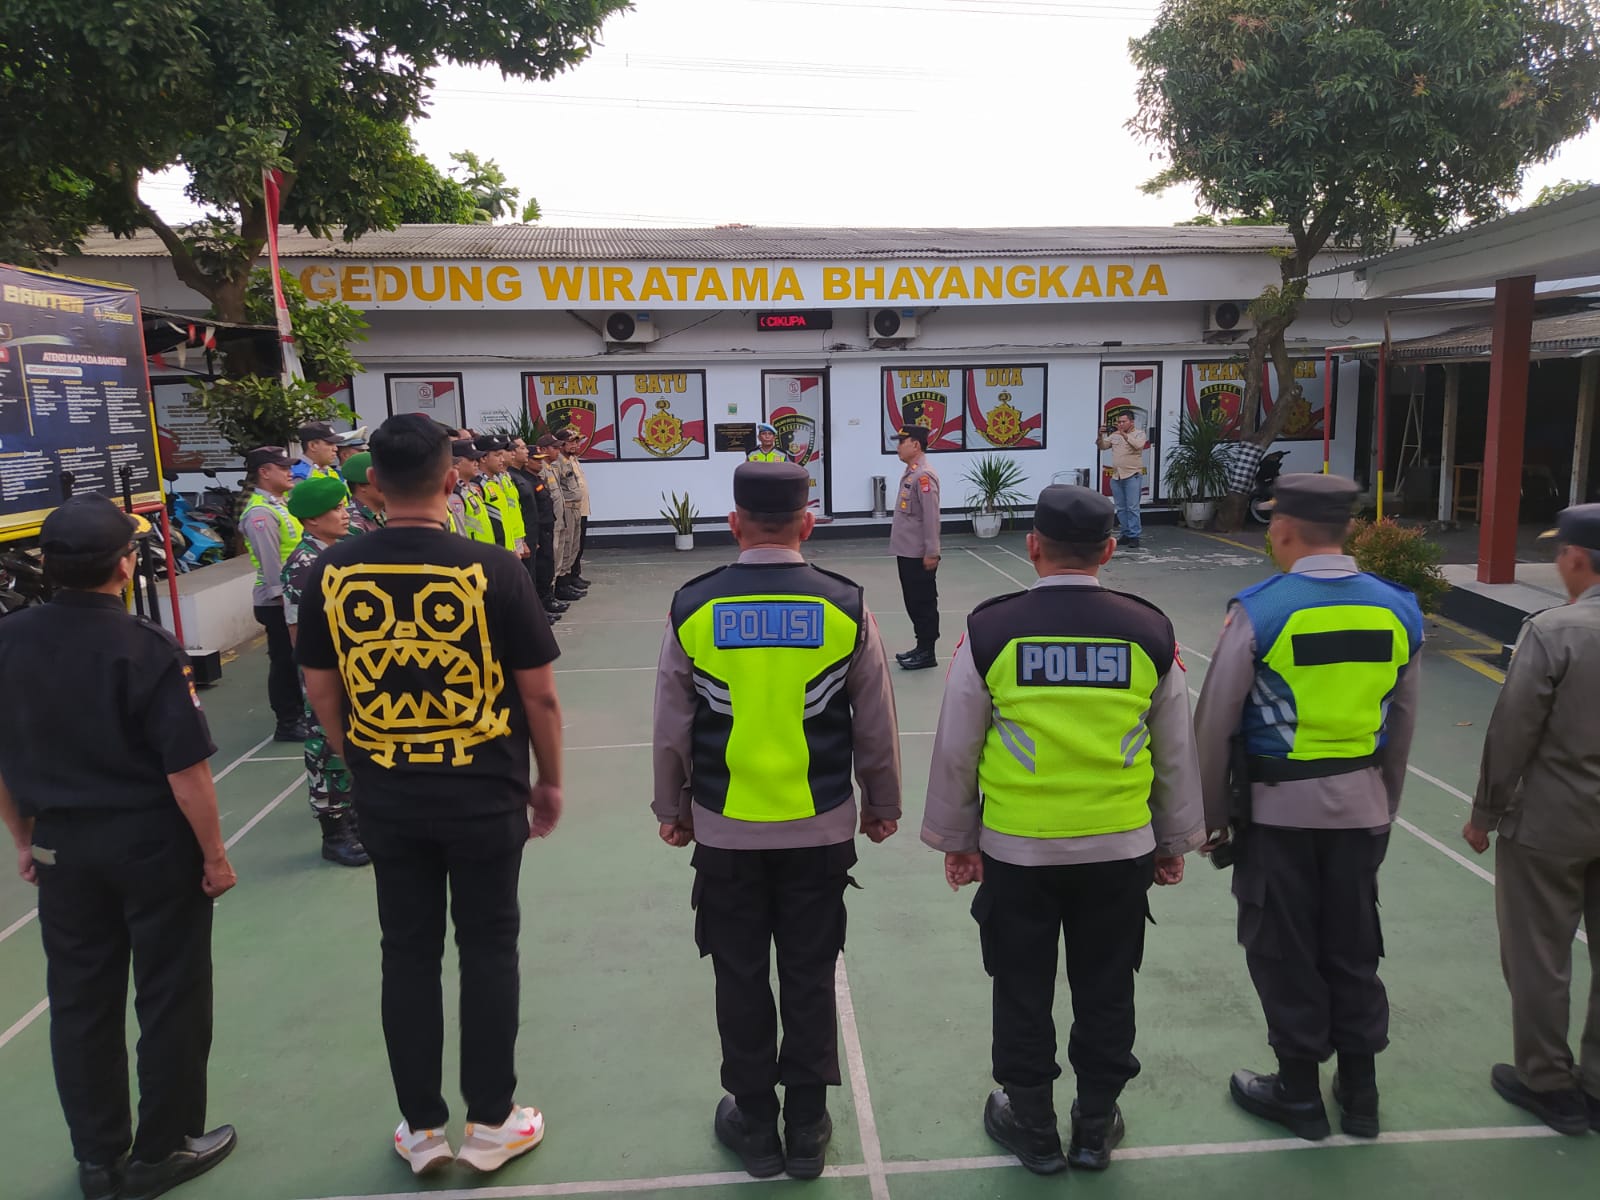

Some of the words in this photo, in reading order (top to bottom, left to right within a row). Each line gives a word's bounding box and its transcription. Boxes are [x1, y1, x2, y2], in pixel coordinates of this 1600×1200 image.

[300, 265, 522, 301] GEDUNG
[538, 266, 804, 301] WIRATAMA
[822, 263, 1168, 300] BHAYANGKARA
[766, 315, 807, 327] CIKUPA
[540, 376, 598, 395] TEAM
[634, 374, 687, 393] SATU
[898, 369, 949, 388] TEAM
[985, 368, 1023, 386] DUA
[719, 609, 819, 641] POLISI
[1022, 645, 1127, 683] POLISI
